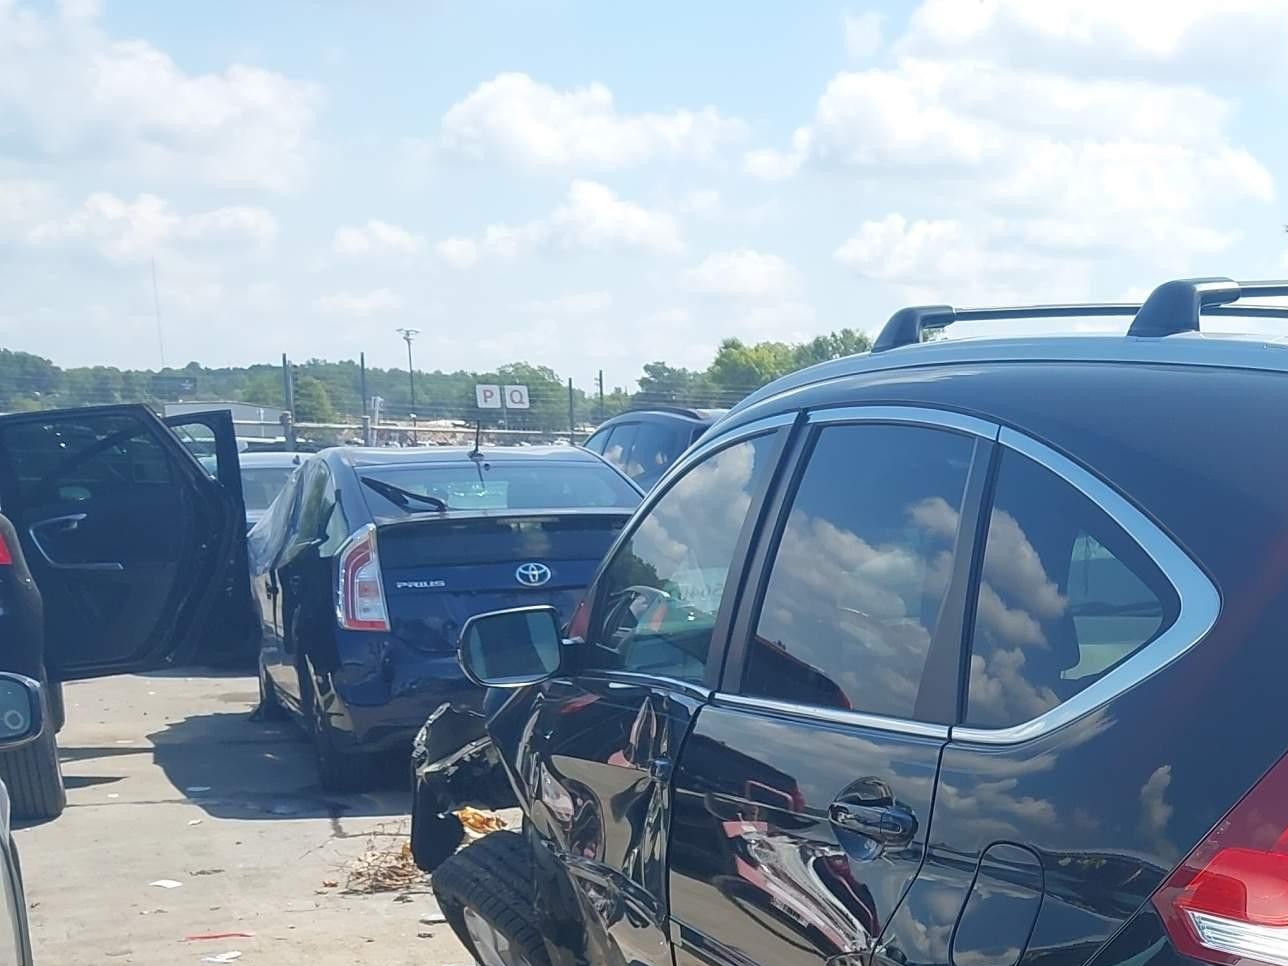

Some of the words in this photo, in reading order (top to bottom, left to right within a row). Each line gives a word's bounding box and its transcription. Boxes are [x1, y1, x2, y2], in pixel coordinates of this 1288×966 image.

[482, 389, 494, 403] P
[510, 389, 525, 405] Q
[396, 580, 446, 589] PRIUS
